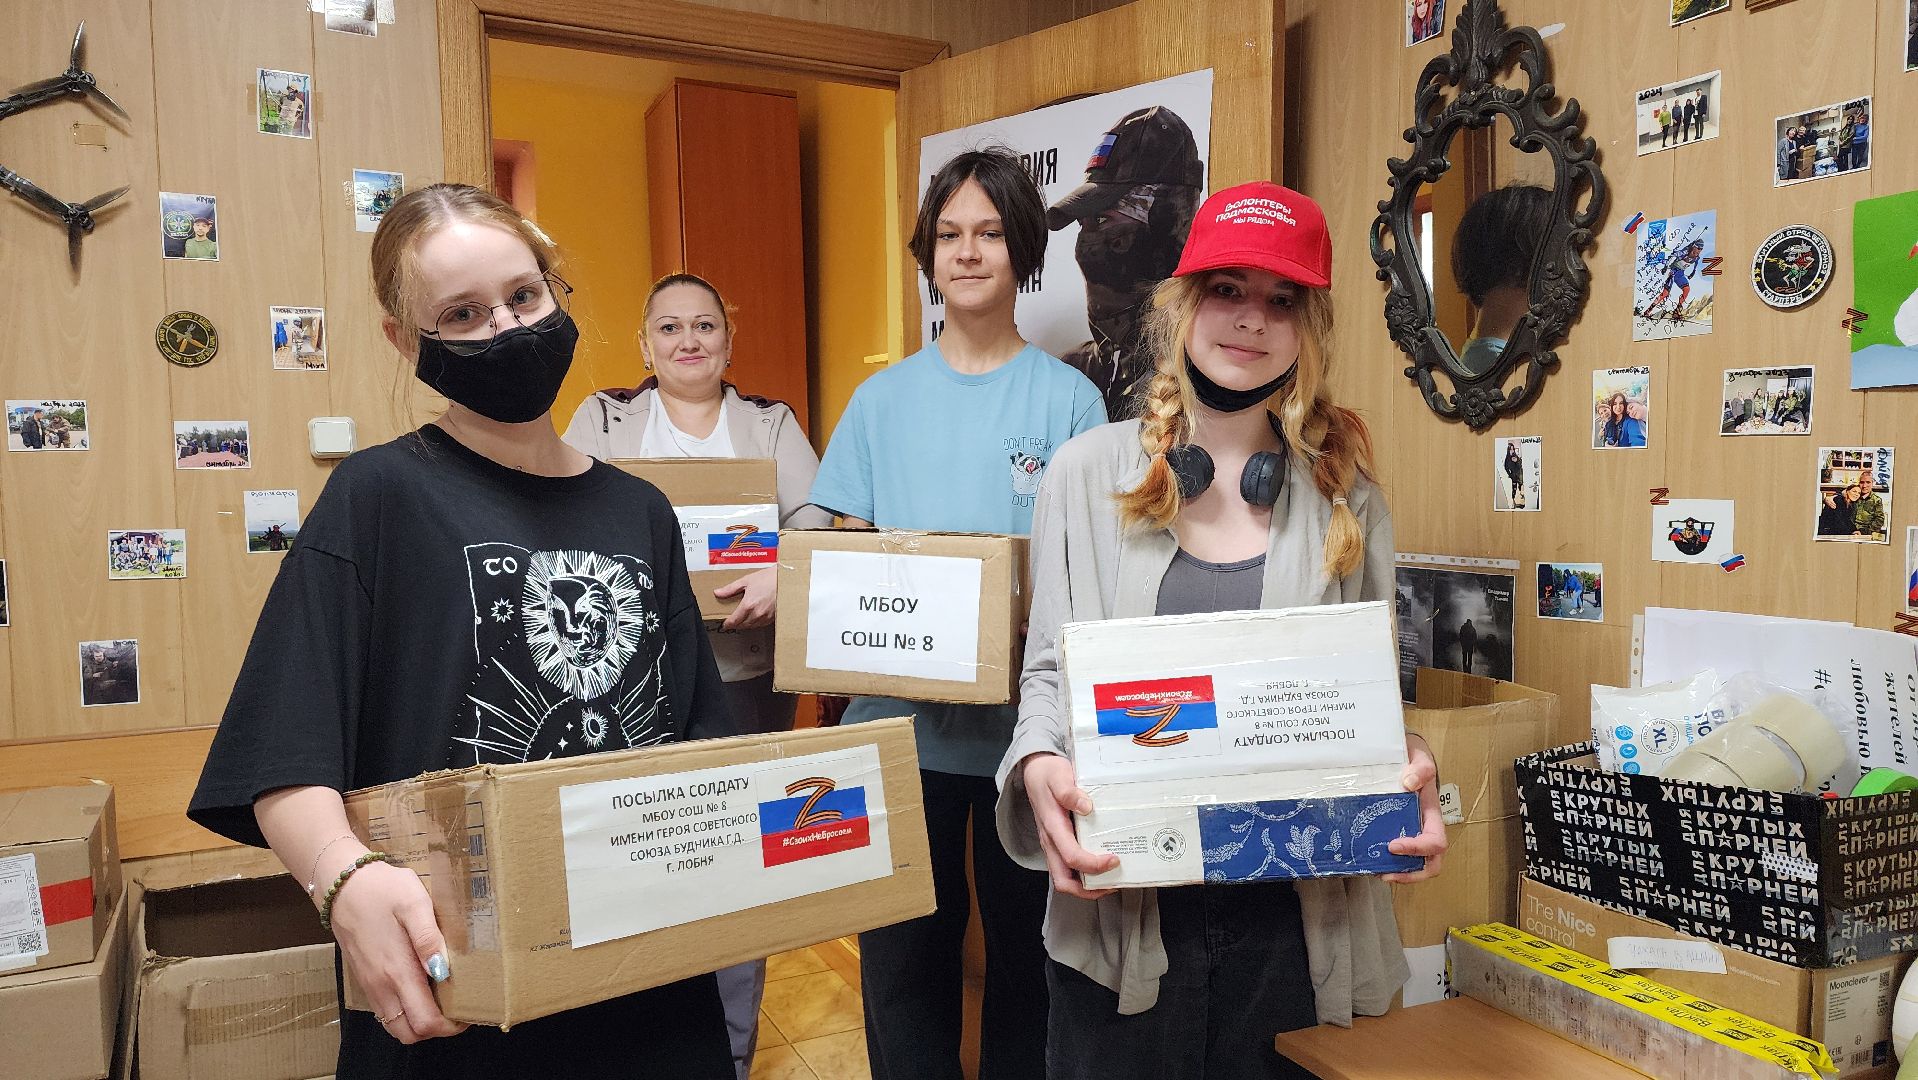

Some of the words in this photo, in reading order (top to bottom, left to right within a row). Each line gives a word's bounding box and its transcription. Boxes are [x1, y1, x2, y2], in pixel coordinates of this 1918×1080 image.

[1225, 198, 1291, 215] ВОЛОНТЕРЫ
[1216, 207, 1296, 227] ПОДМОСКОВЬЯ
[1246, 217, 1275, 226] РЯДОМ
[1004, 437, 1026, 450] DON'T
[1030, 438, 1054, 452] FREAK
[1012, 495, 1036, 507] OUT
[859, 595, 919, 614] МБОУ
[841, 630, 887, 648] СОШ
[894, 633, 916, 650] №
[922, 635, 934, 651] 8
[1238, 695, 1256, 705] Г.Д.
[1257, 692, 1302, 705] БУДНИКА
[1304, 690, 1339, 700] СОЮЗА
[1226, 708, 1286, 719] СОВЕТСКОГО
[1288, 705, 1318, 715] ГЕРОЯ
[1851, 658, 1871, 758] любовью
[1254, 721, 1260, 729] 8
[1262, 721, 1274, 729] №
[1277, 719, 1299, 729] СОШ
[1302, 716, 1330, 726] МБОУ
[1885, 672, 1908, 764] жителей
[1234, 734, 1290, 748] СОЛДАТУ
[1294, 729, 1355, 743] ПОСЫЛКА
[1653, 727, 1667, 748] XL
[612, 786, 685, 809] ПОСЫЛКА
[689, 777, 749, 798] СОЛДАТУ
[1661, 784, 1765, 813] КРУТЫХ
[642, 809, 676, 823] МБОУ
[679, 806, 703, 818] СОШ
[706, 802, 719, 813] №
[721, 801, 727, 811] 8
[1564, 791, 1650, 820] КРУТЫХ
[610, 831, 654, 847] ИМЕНИ
[657, 824, 690, 840] ГЕРОЯ
[693, 813, 757, 833] СОВЕТСКОГО
[1697, 810, 1805, 838] КРУТЫХ
[782, 828, 852, 847] #СвоихНеБросаем
[1575, 831, 1662, 859] КРУТЫХ
[630, 845, 671, 862] СОЮЗА
[674, 835, 724, 854] БУДНИКА
[726, 833, 745, 846] Г.Д.
[667, 863, 674, 873] Г.
[678, 855, 714, 871] ЛОБНЯ
[1526, 894, 1554, 919] The
[1557, 907, 1596, 938] Nice
[1526, 917, 1576, 950] control
